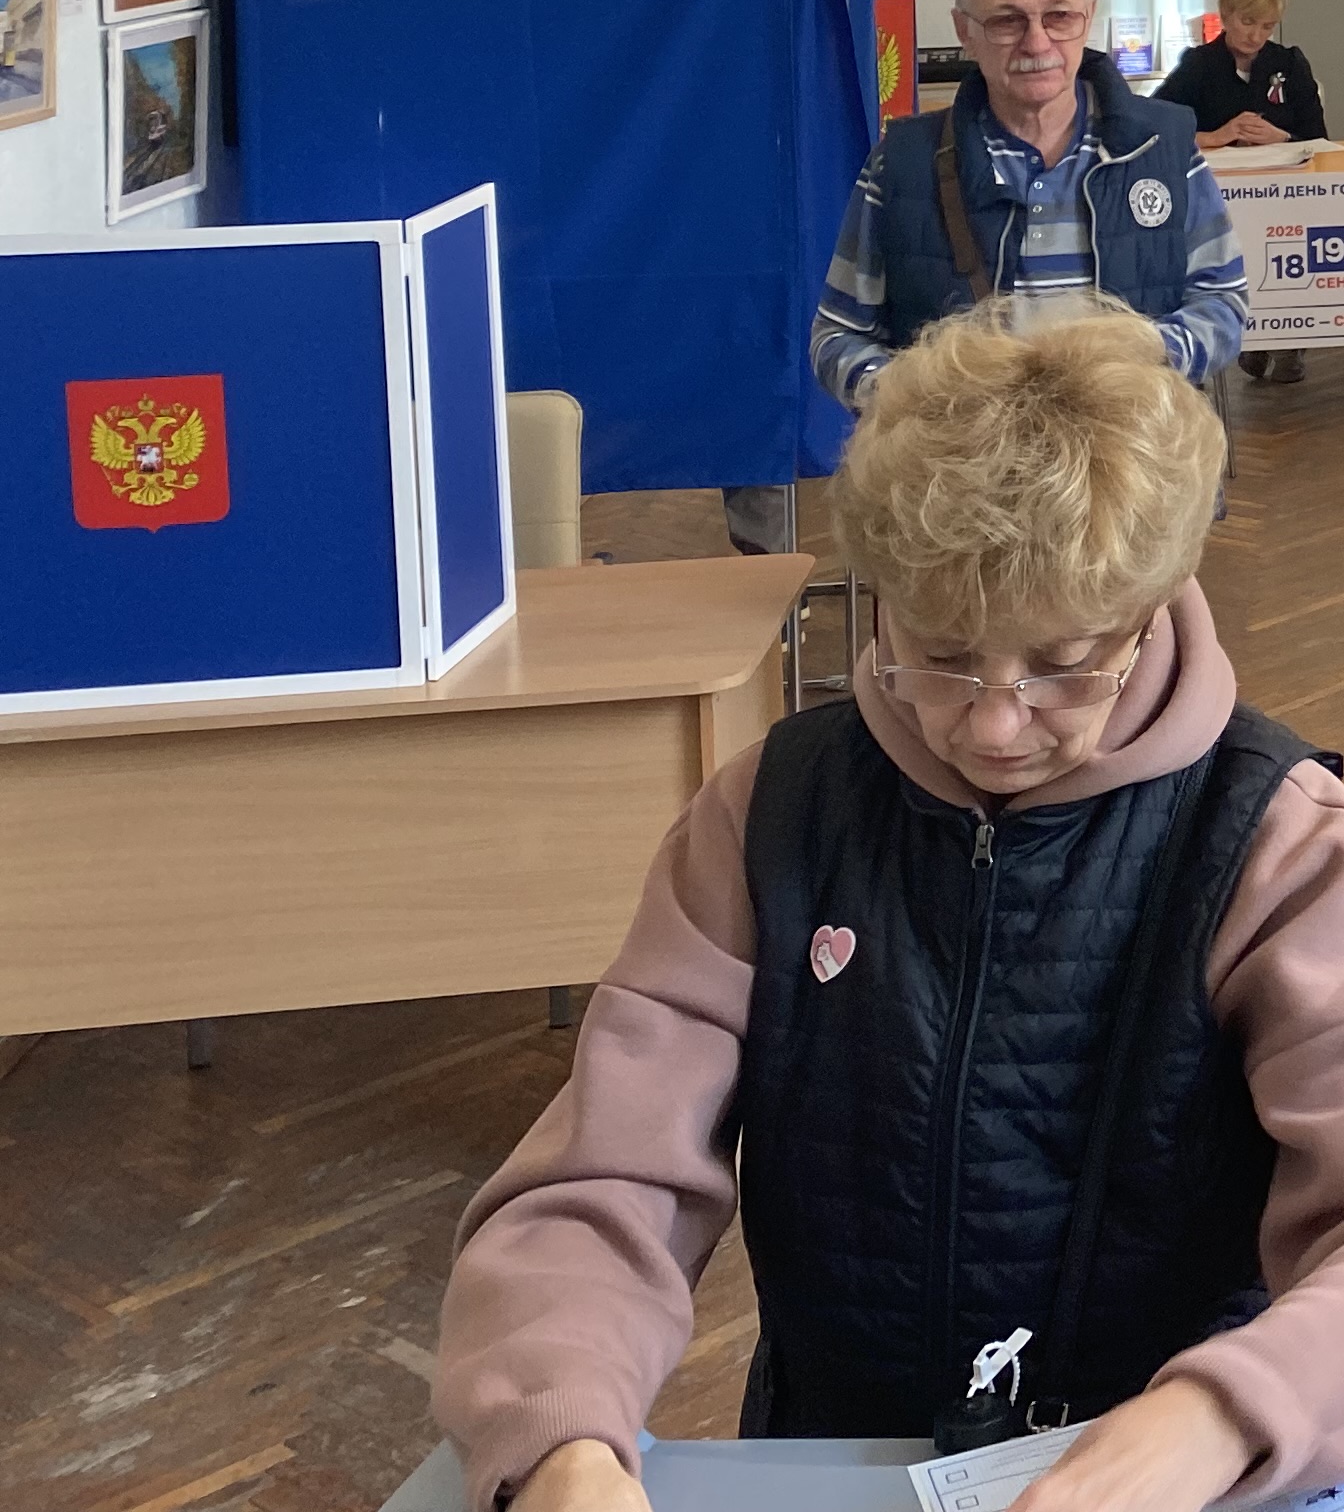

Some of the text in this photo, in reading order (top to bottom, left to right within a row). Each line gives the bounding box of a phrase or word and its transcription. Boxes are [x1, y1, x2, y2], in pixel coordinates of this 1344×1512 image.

[1221, 184, 1280, 201] ДИНЫЙ
[1284, 185, 1327, 200] ДЕНЬ
[1266, 225, 1304, 238] 2026
[1271, 254, 1305, 280] 18
[1261, 316, 1315, 331] ГОЛОС
